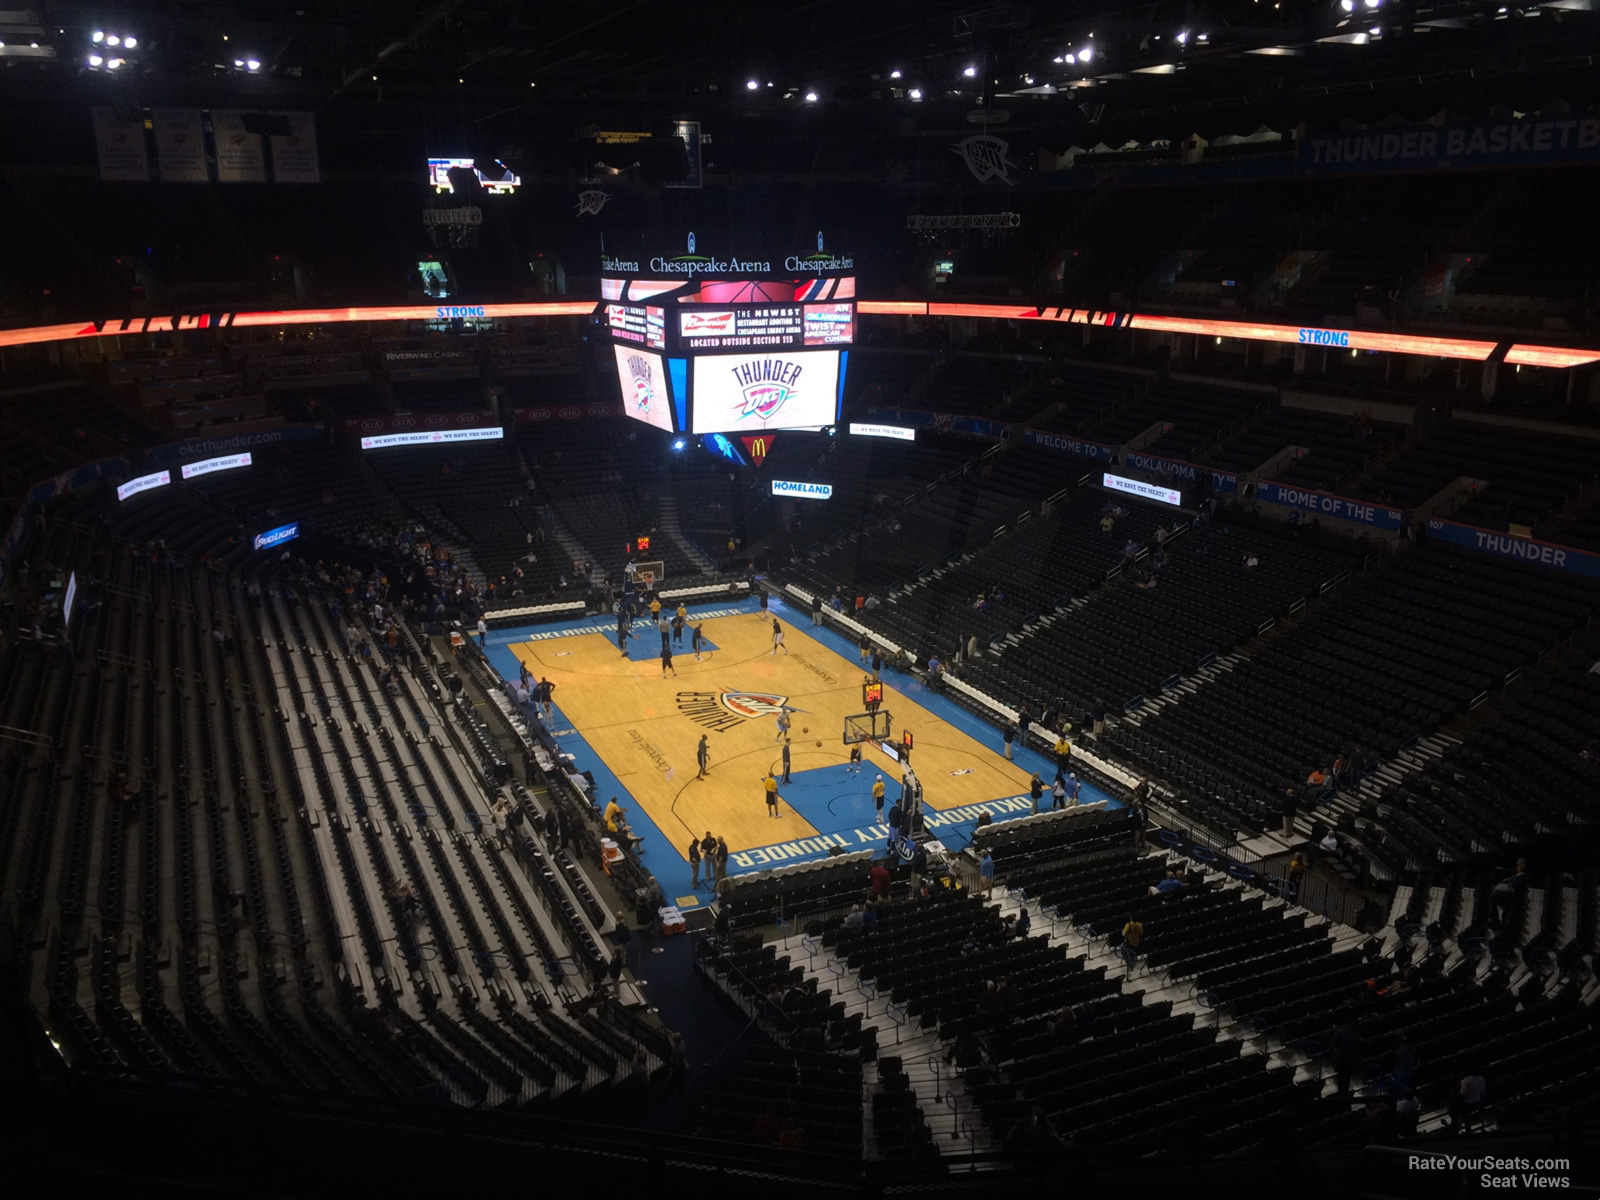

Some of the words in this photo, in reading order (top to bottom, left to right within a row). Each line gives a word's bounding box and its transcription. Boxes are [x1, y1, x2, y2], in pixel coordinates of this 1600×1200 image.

[1311, 130, 1438, 163] THUNDER
[1447, 118, 1600, 156] BASKETB
[615, 257, 639, 272] Arena
[650, 256, 727, 278] Chesapeake
[729, 257, 771, 273] Arena
[785, 255, 840, 276] Chesapeake
[436, 305, 484, 318] STRONG
[736, 310, 751, 318] THE
[754, 308, 800, 317] NEWEST
[835, 304, 849, 313] AN
[736, 318, 768, 327] RESTAURANT
[769, 318, 793, 326] ADDITION
[804, 322, 835, 331] TWIST
[737, 328, 766, 336] CHESAPEAKE
[785, 326, 801, 334] ARENA
[804, 330, 840, 338] AMERICAN
[1299, 328, 1349, 347] STRONG
[690, 338, 720, 348] LOCATED
[722, 337, 751, 346] OUTSIDE
[752, 336, 781, 345] SECTION
[782, 335, 794, 344] 115
[386, 352, 432, 361] RIVERWIND
[433, 351, 465, 360] CASINO
[731, 359, 803, 387] THUNDER
[530, 410, 549, 419] KIA
[562, 409, 578, 418] KIA
[591, 407, 606, 415] KIA
[363, 420, 382, 431] KIA
[395, 418, 413, 428] KIA
[427, 416, 446, 427] KIA
[458, 414, 477, 425] KIA
[179, 431, 282, 457] okcthunder.com
[1035, 433, 1081, 453] WELCOME
[1084, 443, 1098, 457] TO
[1135, 455, 1196, 481] OKLAHOMA
[1115, 479, 1124, 487] WE
[1124, 482, 1137, 491] HAVE
[1137, 485, 1147, 493] THE
[1225, 475, 1237, 483] 105
[774, 481, 830, 495] HOMELAND
[1257, 482, 1269, 491] 106
[1278, 487, 1317, 509] HOME
[1321, 498, 1342, 514] OF
[1346, 503, 1375, 522] THE
[1388, 510, 1402, 521] 106
[1429, 520, 1444, 530] 107
[275, 527, 297, 541] LIGHT
[1476, 531, 1567, 567] THUNDER
[675, 692, 747, 733] THUNDER
[923, 796, 1033, 829] OKLAHOM
[854, 823, 890, 843] ITY
[731, 833, 853, 868] THUNDER
